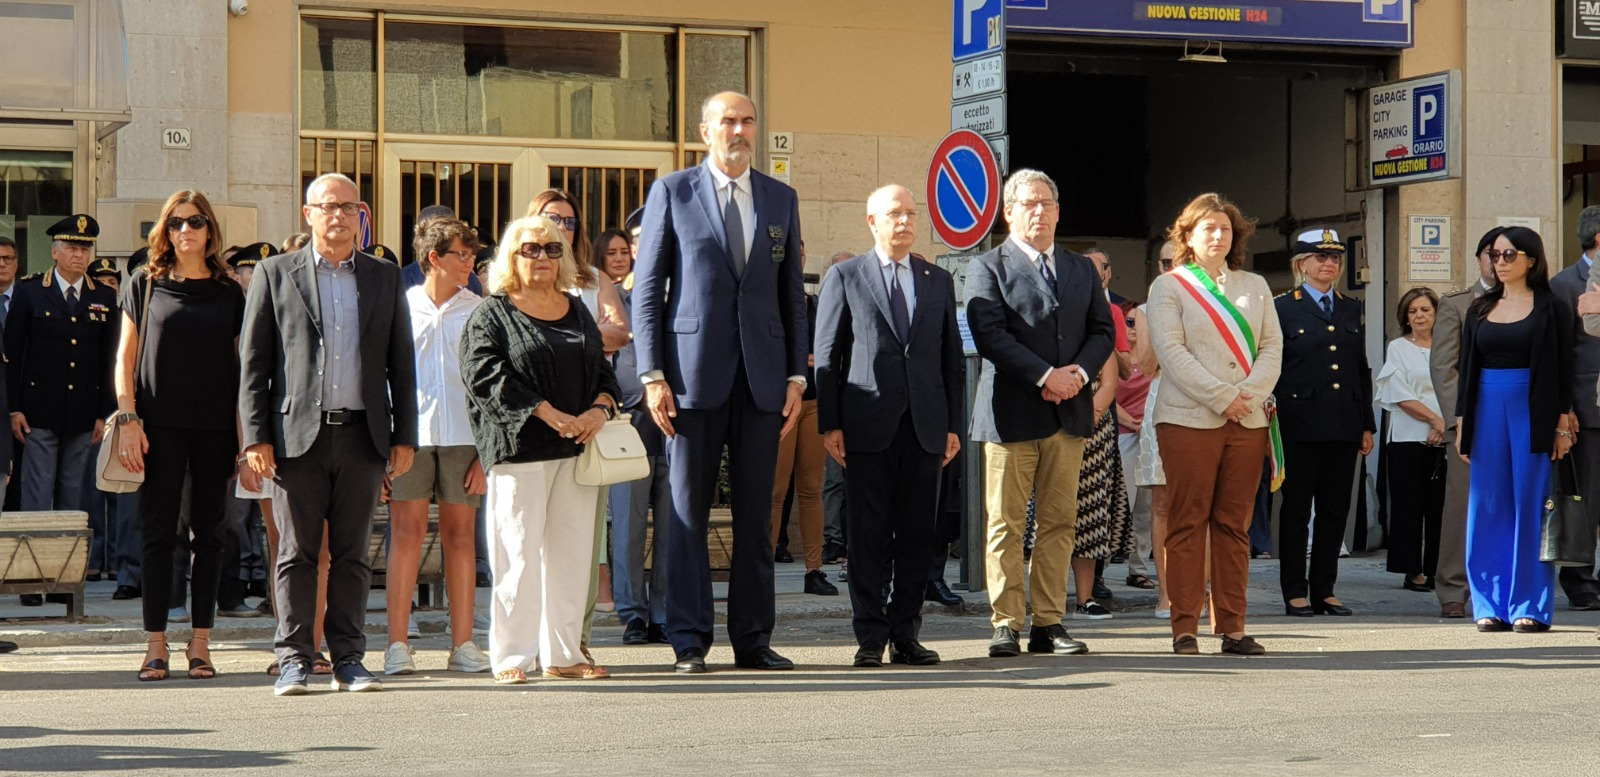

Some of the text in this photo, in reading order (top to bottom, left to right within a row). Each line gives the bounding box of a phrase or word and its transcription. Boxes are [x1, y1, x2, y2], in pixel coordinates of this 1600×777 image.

[1147, 5, 1268, 22] NUOVA GESTIONE H24
[1373, 89, 1407, 106] GARAGE
[964, 104, 990, 119] eccetto
[1373, 110, 1391, 123] CITY
[1420, 94, 1437, 136] P
[166, 131, 188, 144] 10A
[1373, 125, 1408, 141] PARKING
[774, 135, 788, 149] 12
[1413, 140, 1444, 154] ORARIO
[1374, 161, 1396, 176] NUOVA
[1397, 158, 1428, 174] GESTIONE
[1424, 227, 1438, 244] P
